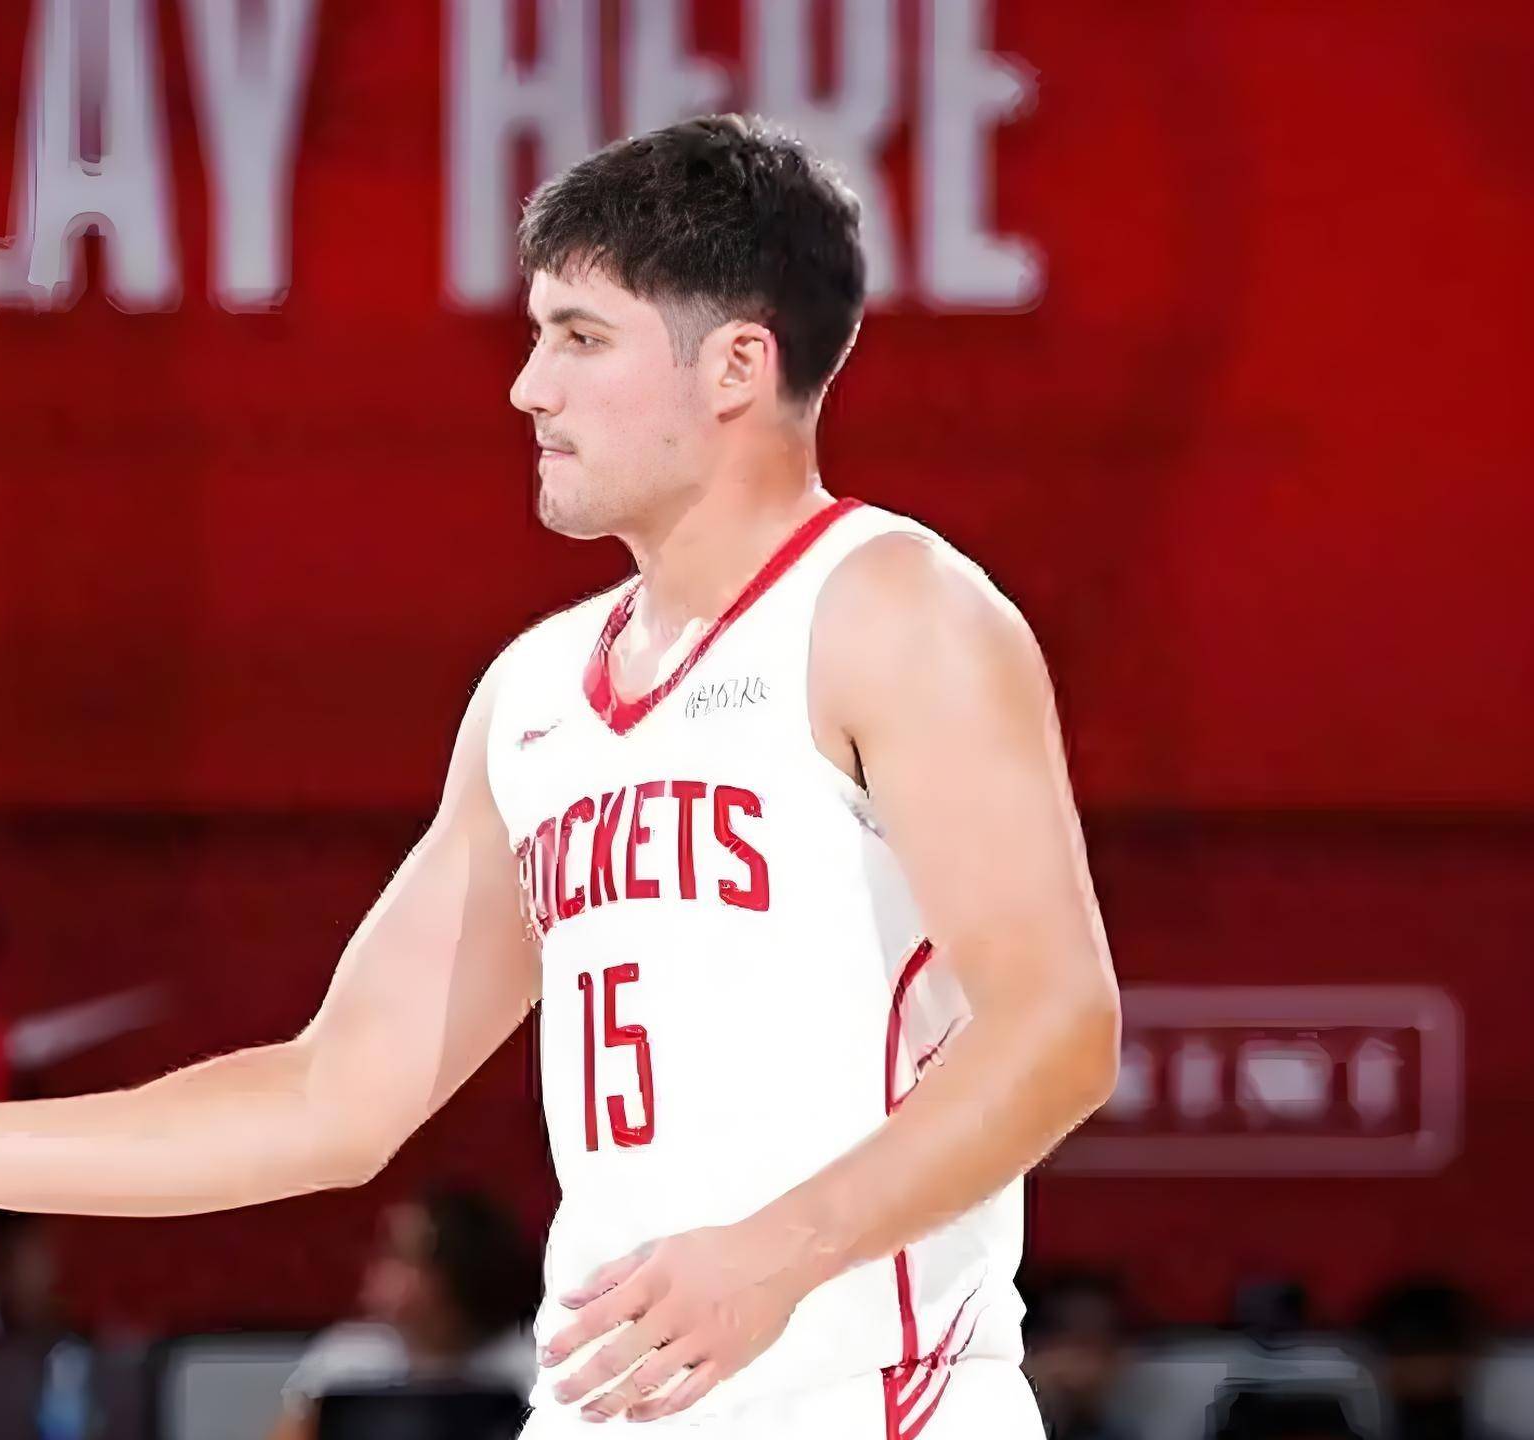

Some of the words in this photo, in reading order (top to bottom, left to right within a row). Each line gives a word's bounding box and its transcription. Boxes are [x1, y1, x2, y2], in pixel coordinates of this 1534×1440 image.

[444, 0, 1044, 313] HRE
[516, 780, 770, 933] OCKETS
[577, 962, 655, 1152] 15
